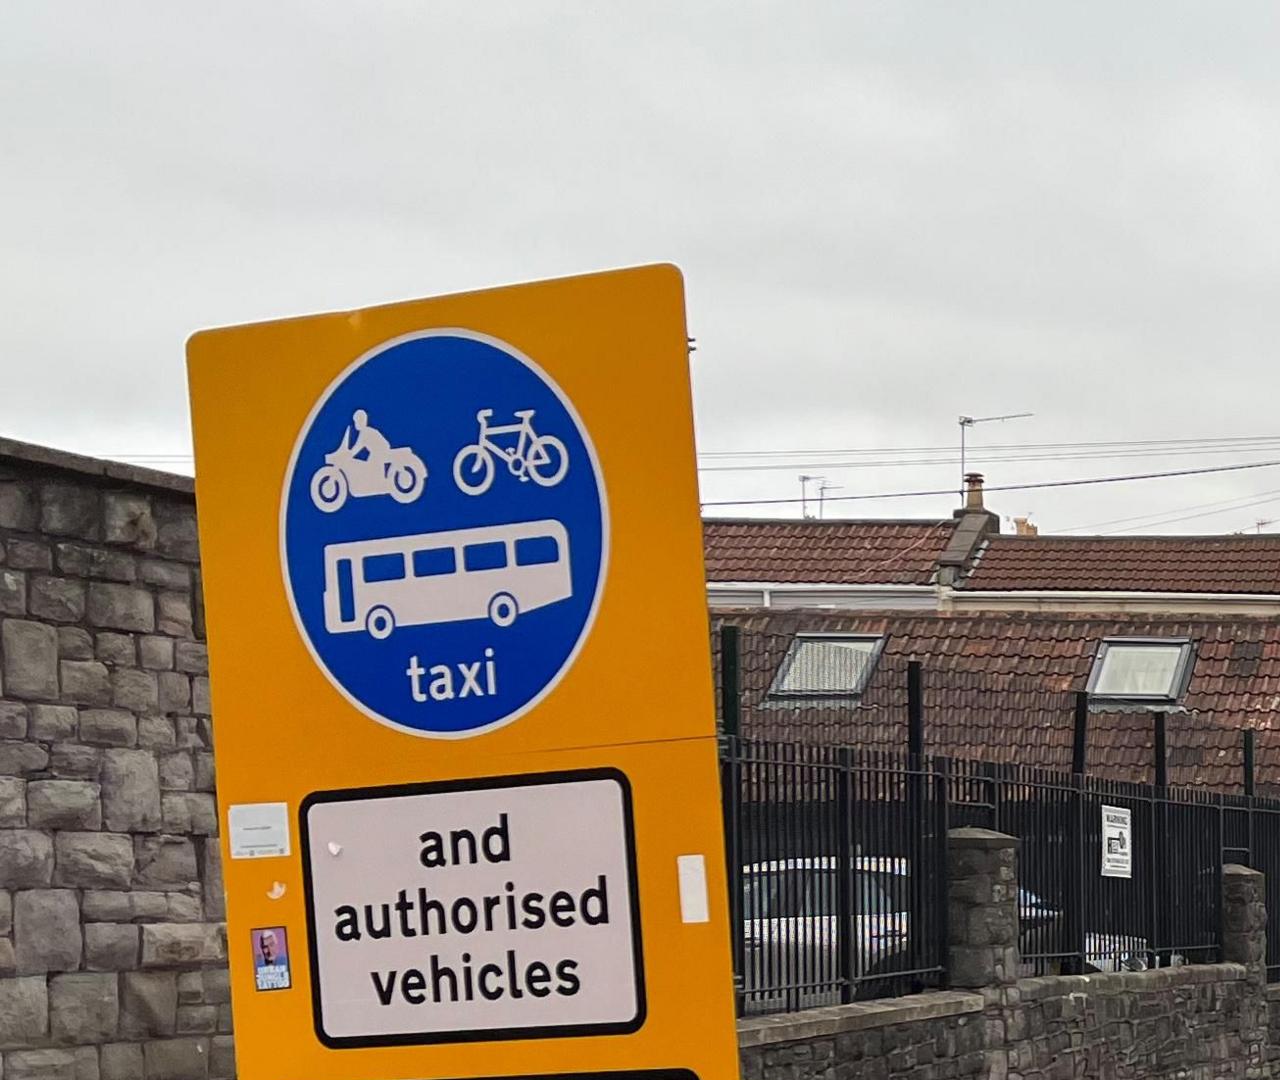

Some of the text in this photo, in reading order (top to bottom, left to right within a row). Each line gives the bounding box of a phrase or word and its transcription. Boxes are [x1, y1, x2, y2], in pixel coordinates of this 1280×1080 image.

[406, 647, 496, 702] taxi
[419, 812, 511, 868] and
[334, 874, 610, 942] authorised
[370, 949, 581, 1006] vehicles
